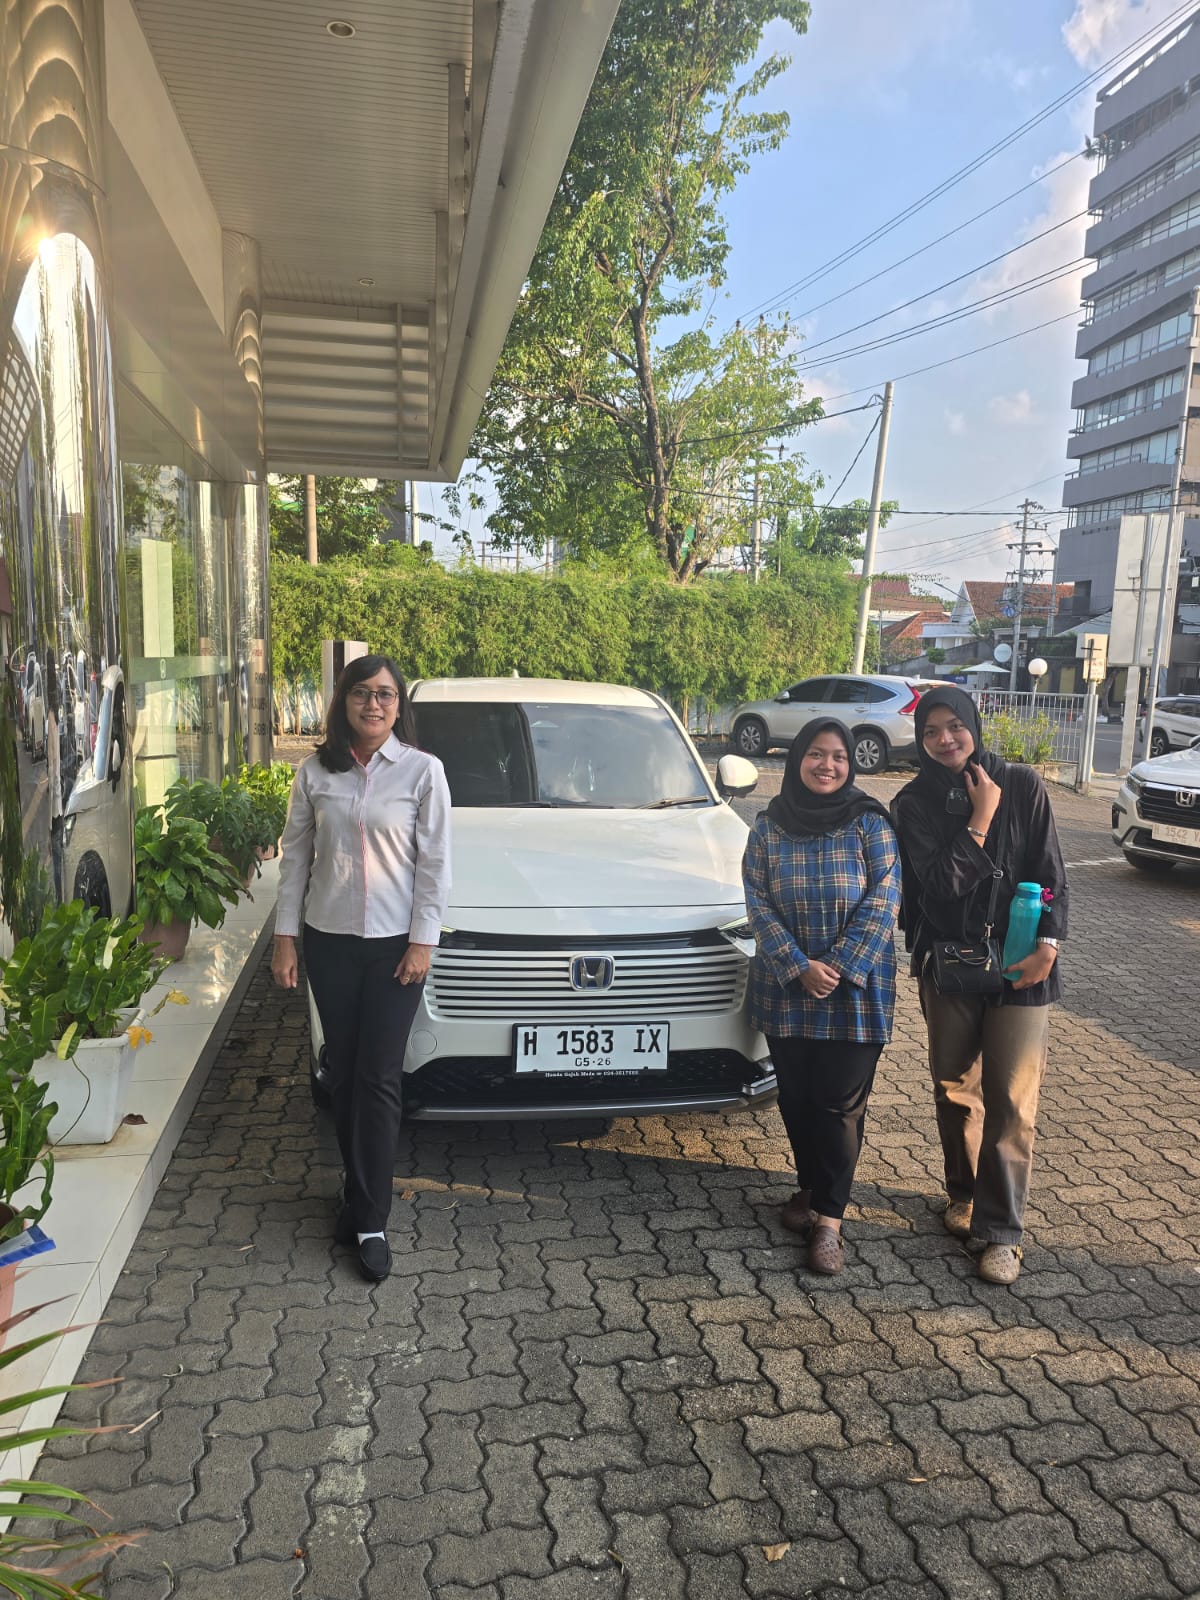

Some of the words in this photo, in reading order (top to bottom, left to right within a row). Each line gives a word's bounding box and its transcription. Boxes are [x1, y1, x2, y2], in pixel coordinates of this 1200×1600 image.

[523, 1031, 538, 1056] H
[556, 1029, 614, 1056] 1583
[633, 1028, 661, 1053] IX
